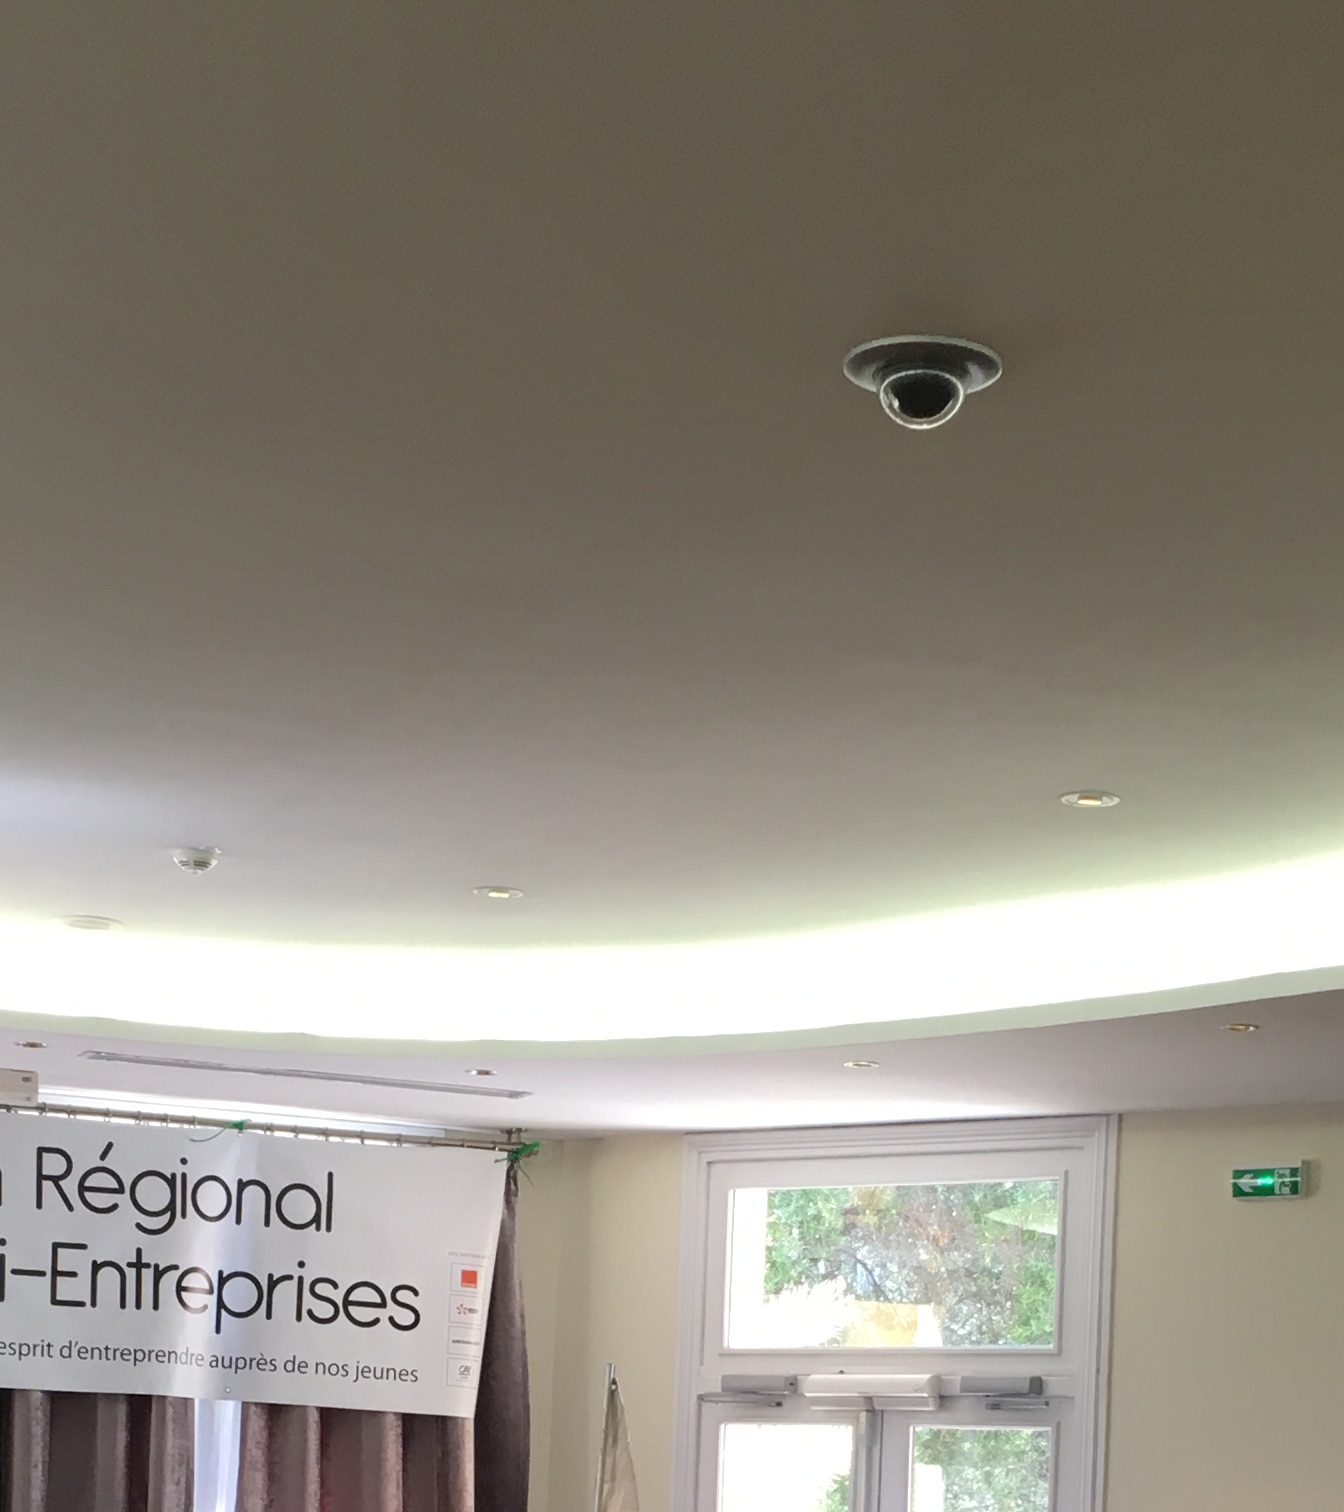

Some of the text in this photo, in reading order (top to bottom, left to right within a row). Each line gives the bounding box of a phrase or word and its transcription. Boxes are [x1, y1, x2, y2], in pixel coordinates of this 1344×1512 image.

[35, 1140, 333, 1236] Régional
[209, 1353, 278, 1374] auprès
[283, 1355, 309, 1374] de
[314, 1361, 348, 1377] nos
[353, 1361, 419, 1383] jeunes
